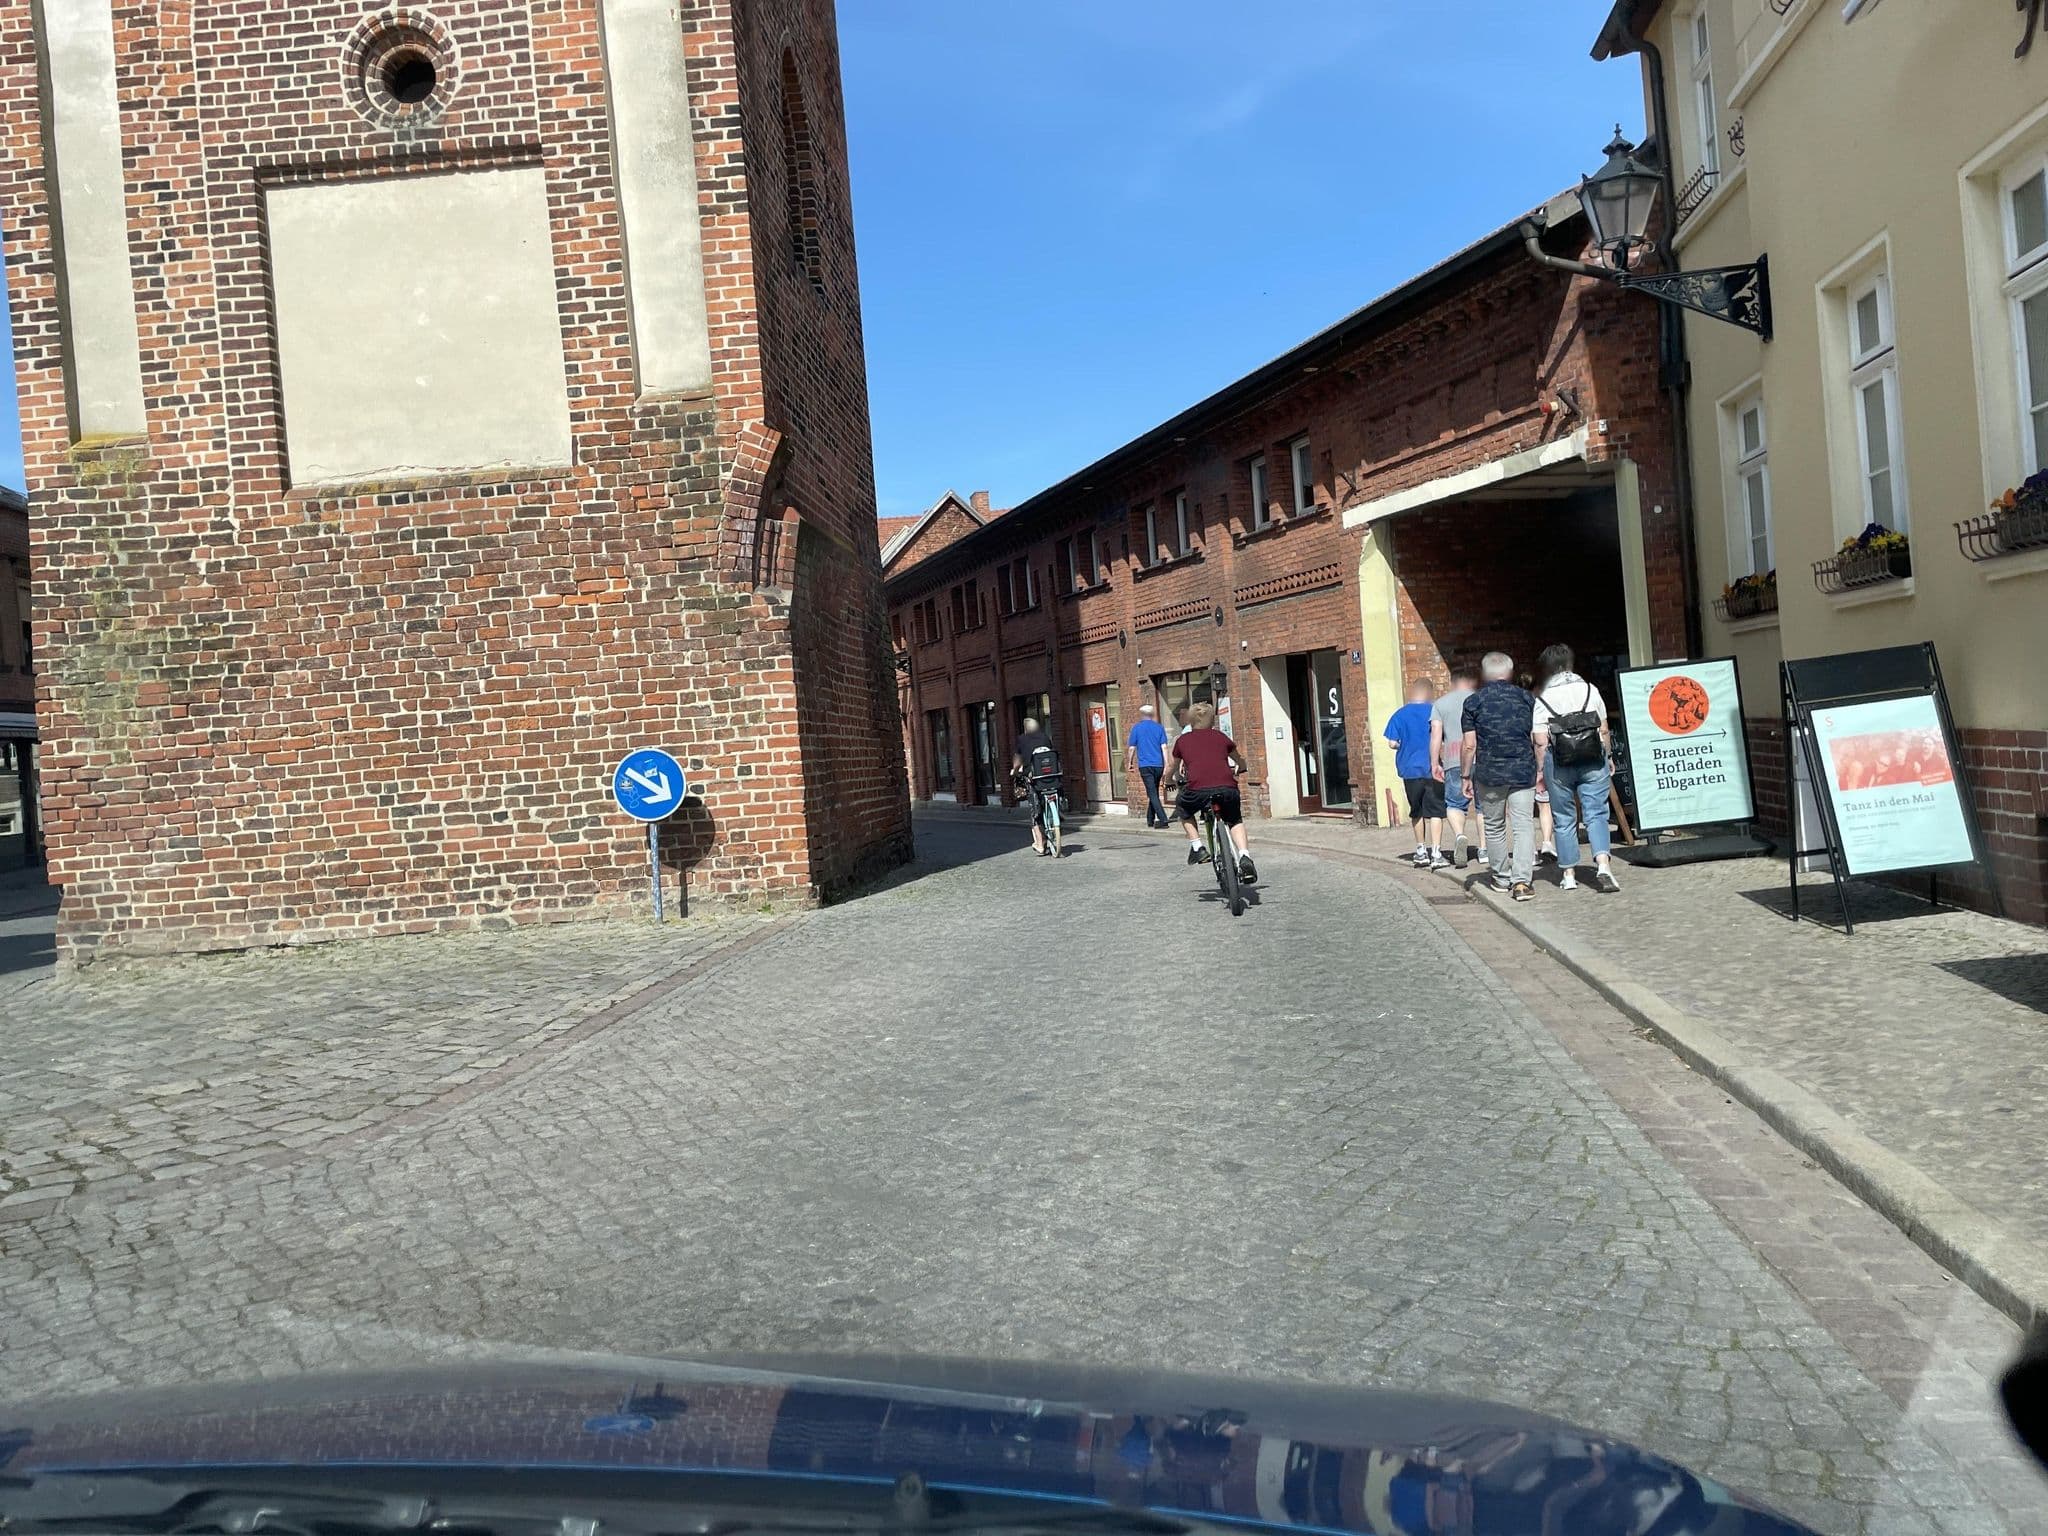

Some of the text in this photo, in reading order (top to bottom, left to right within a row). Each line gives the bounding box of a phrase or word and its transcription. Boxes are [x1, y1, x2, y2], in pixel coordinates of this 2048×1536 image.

[1328, 687, 1339, 715] S
[1653, 742, 1714, 760] Brauerei
[1655, 758, 1723, 775] Hofladen
[1657, 774, 1727, 791] Elbgarten
[1843, 792, 1935, 812] Tanz in den Mai
